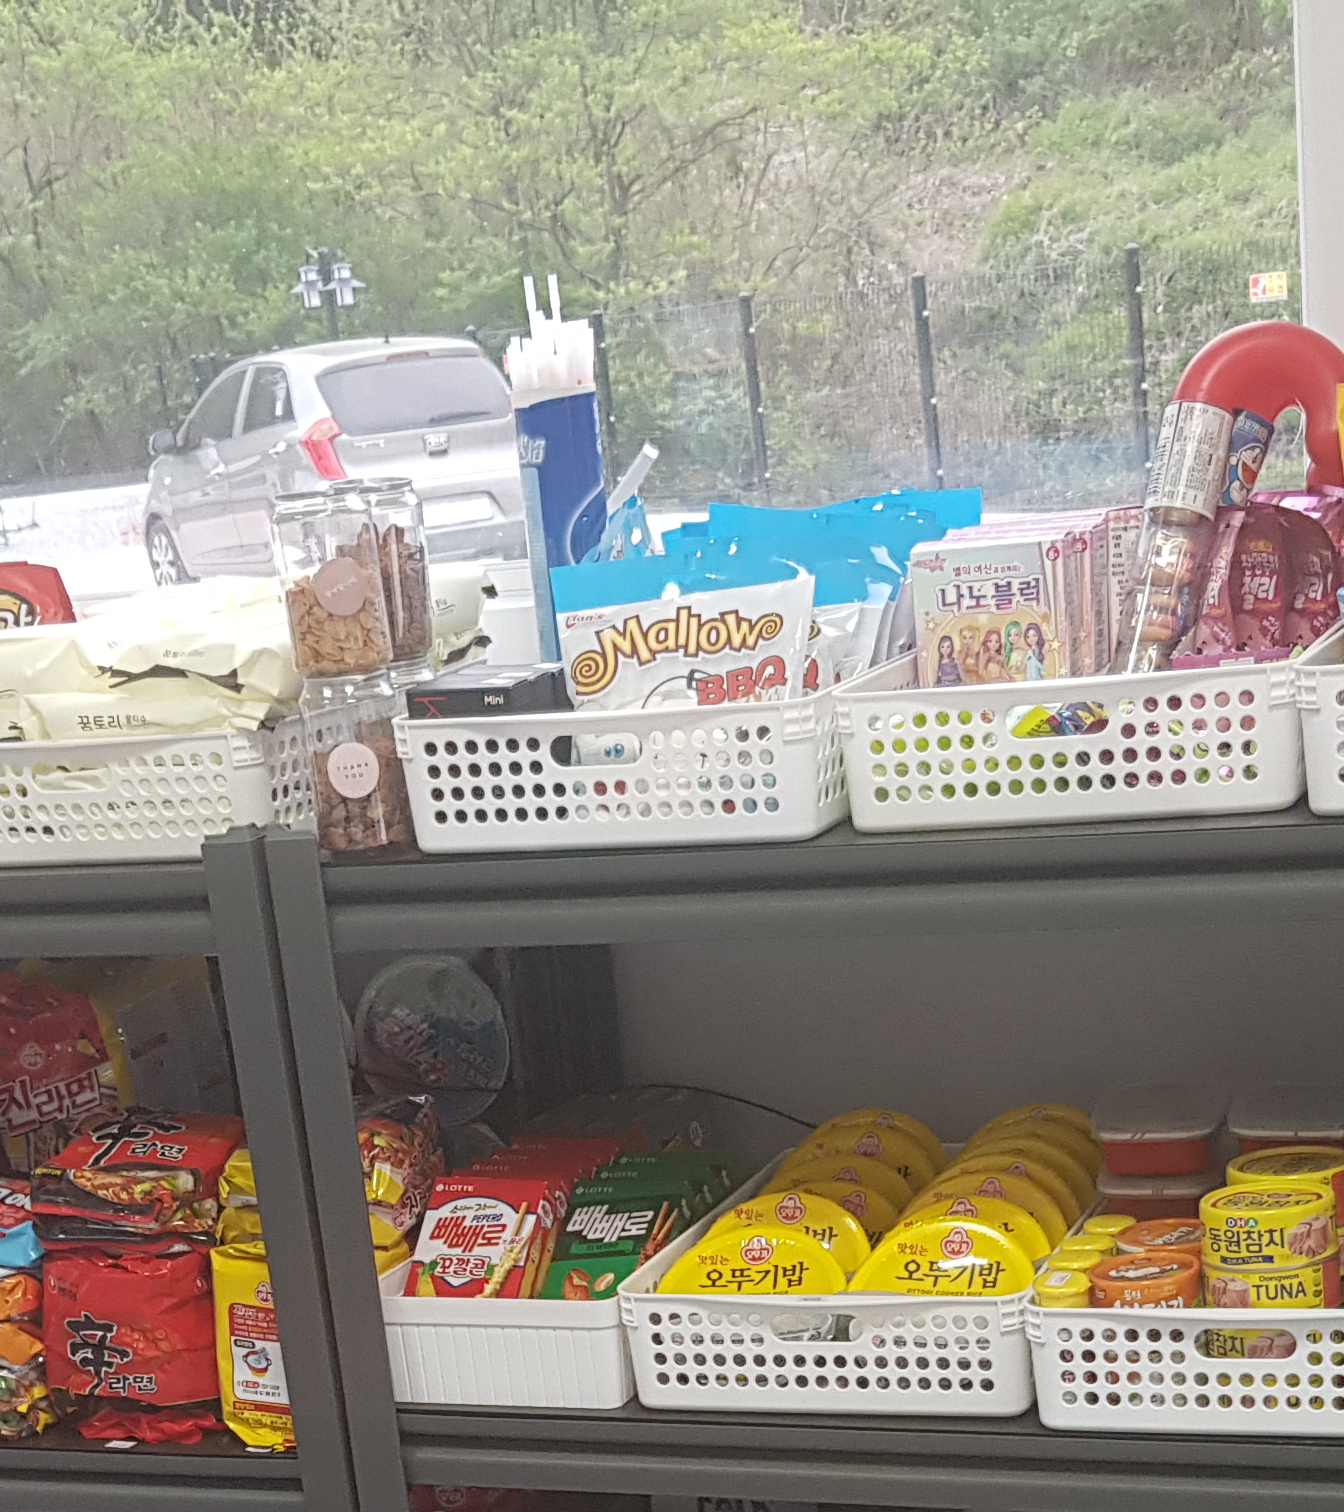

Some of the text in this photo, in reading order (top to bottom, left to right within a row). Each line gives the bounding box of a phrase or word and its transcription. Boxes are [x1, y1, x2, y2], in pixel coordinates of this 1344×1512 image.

[939, 577, 1042, 613] 나노블럭
[571, 605, 783, 697] Mallow
[696, 655, 788, 706] BBQ
[484, 694, 504, 706] Mini
[444, 1184, 475, 1193] LOTTE
[429, 1214, 507, 1255] 빼빼로
[1226, 1217, 1258, 1228] DHA
[1209, 1227, 1285, 1254] 동원참치
[698, 1261, 810, 1293] 오뚜기밥
[895, 1258, 1007, 1290] 오뚜기밥
[1252, 1281, 1307, 1301] TUNA
[108, 1375, 157, 1394] 라면
